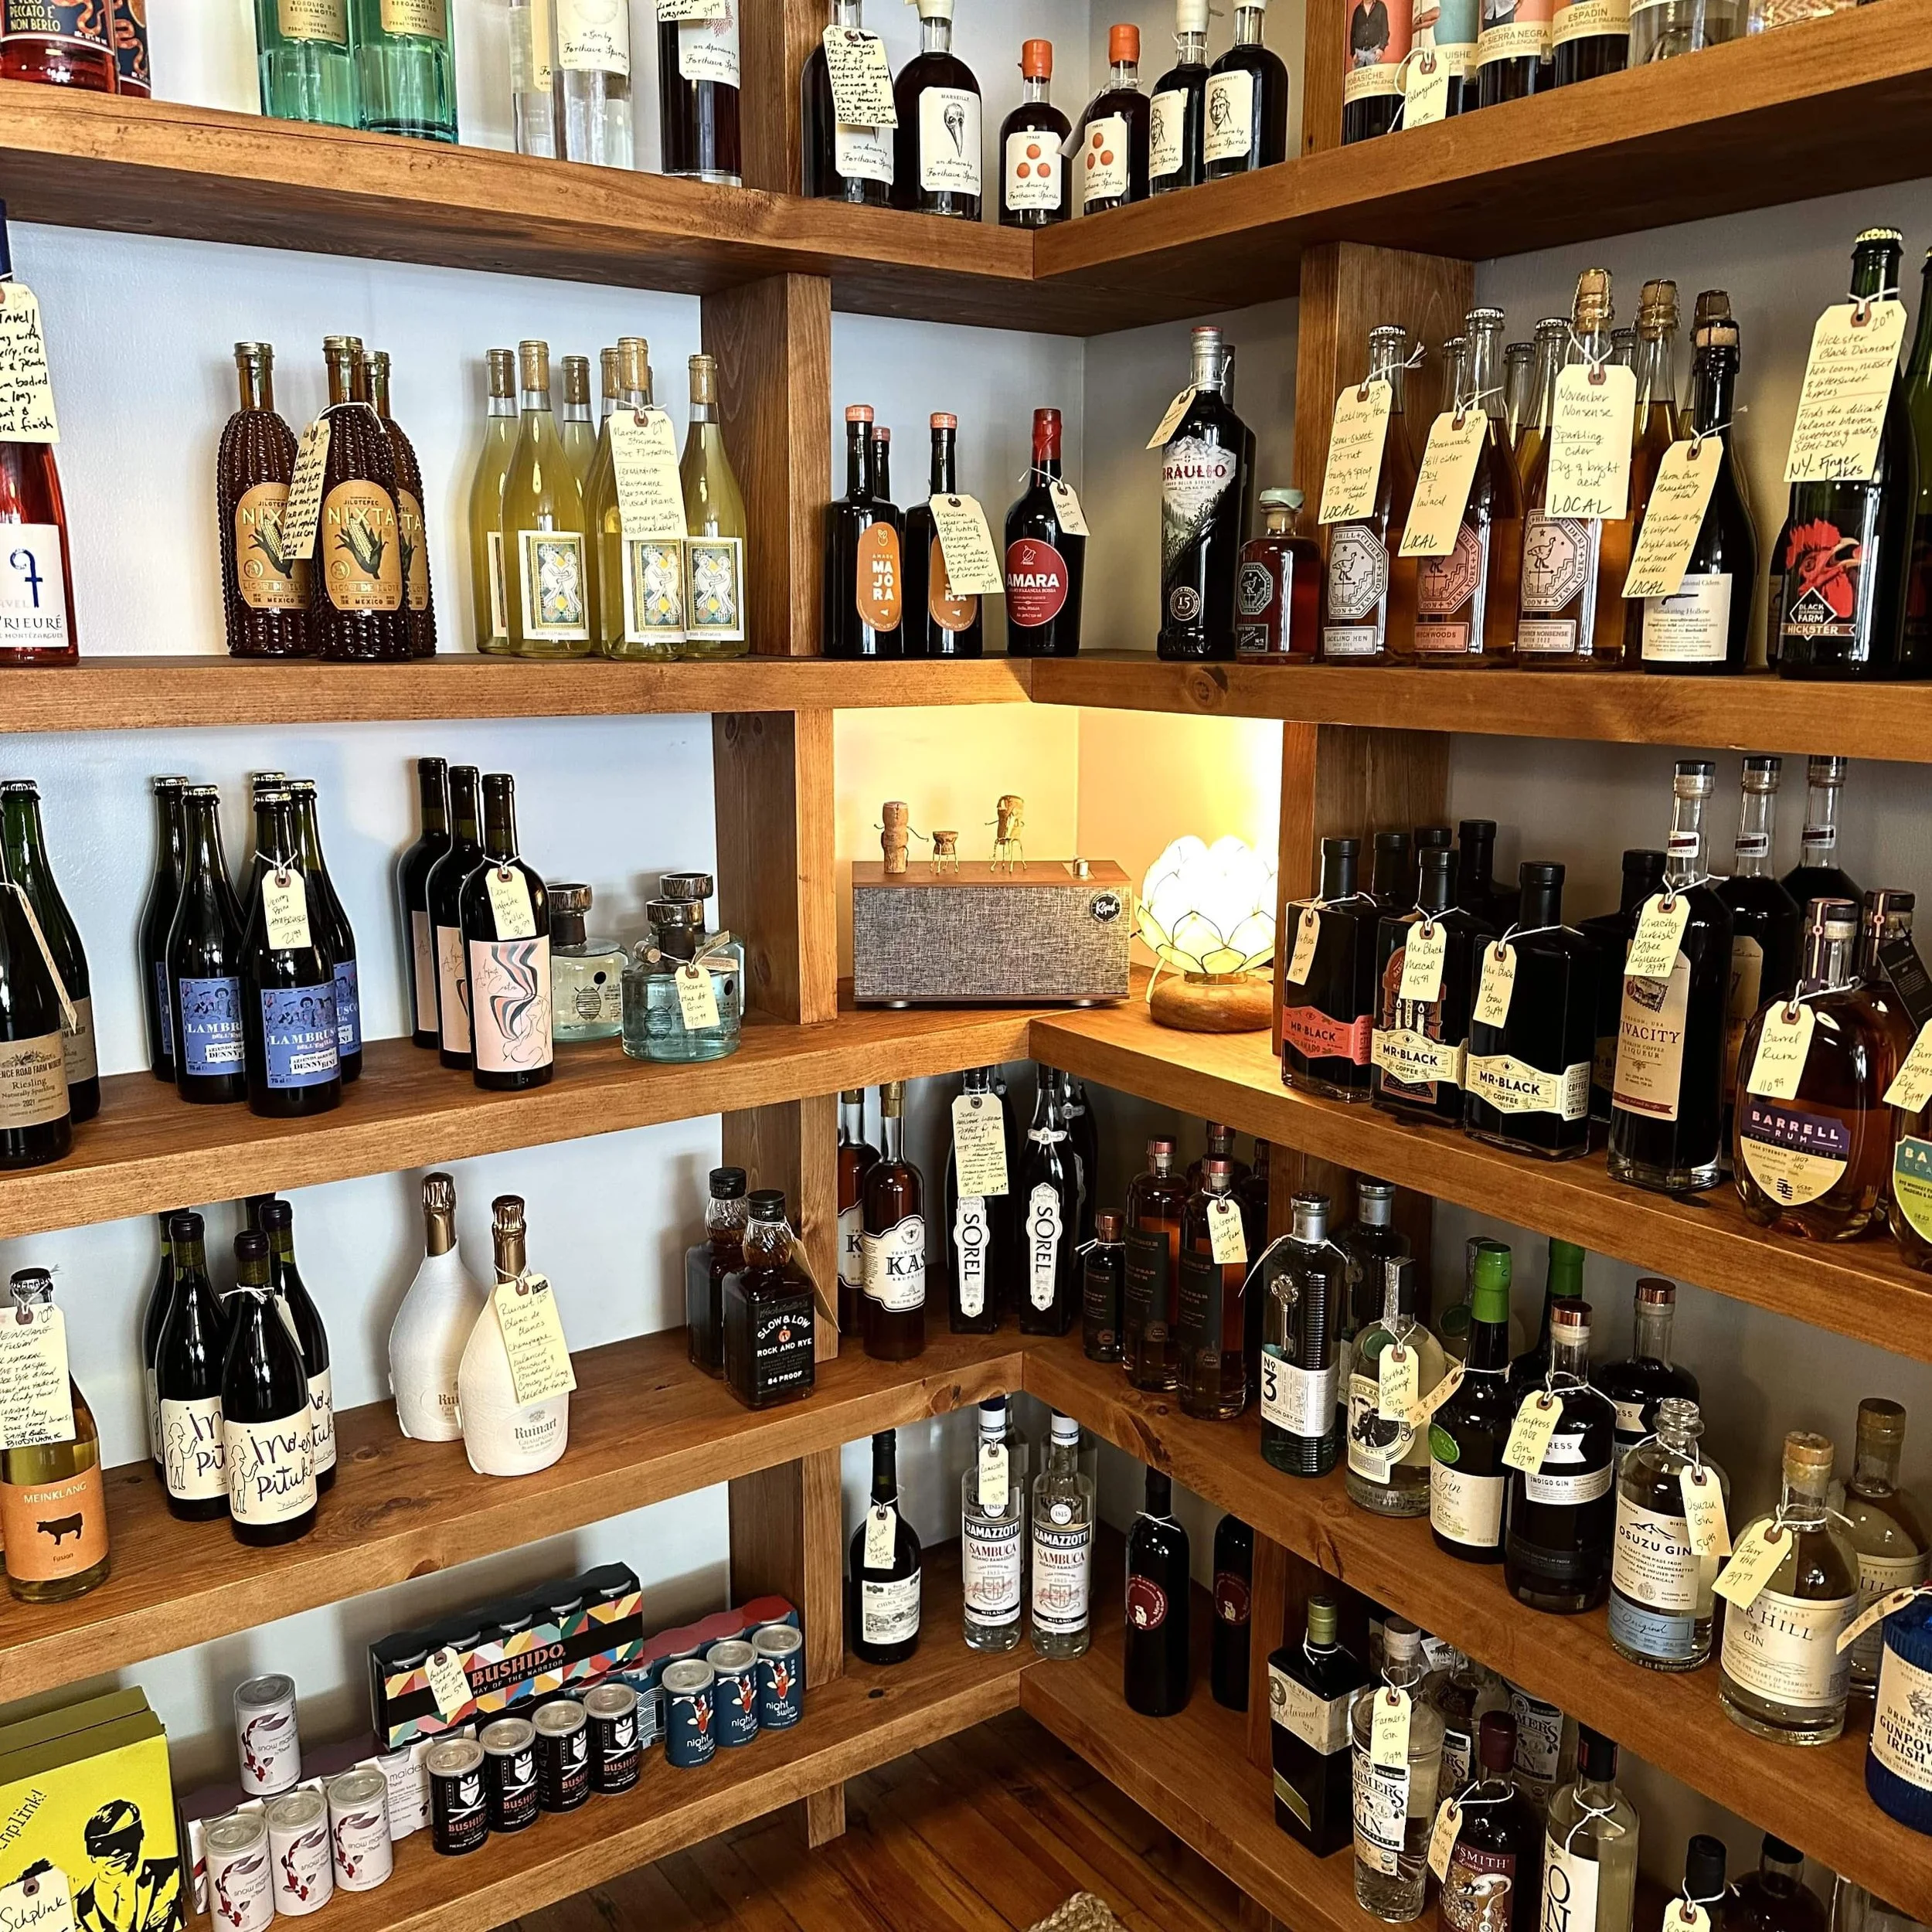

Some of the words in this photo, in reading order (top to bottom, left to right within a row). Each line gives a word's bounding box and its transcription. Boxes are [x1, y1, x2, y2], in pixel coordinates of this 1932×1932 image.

[10, 6, 45, 17] PECCATO
[1567, 8, 1609, 23] ESPADIN
[11, 19, 29, 31] NON
[31, 20, 60, 32] BERLO
[1488, 32, 1515, 44] SIERRA
[1518, 29, 1548, 39] NEGRA
[940, 94, 971, 102] MARSEILLE
[1819, 345, 1849, 359] Black
[1557, 389, 1610, 403] November
[1562, 405, 1614, 418] Nonsense
[1323, 505, 1359, 519] LOCAL
[1551, 495, 1612, 515] LOCAL
[328, 508, 395, 526] NIXTA
[1403, 528, 1437, 549] LOCAL
[872, 561, 894, 573] MA
[1007, 573, 1059, 587] AMARA
[872, 588, 895, 600] RA
[1551, 584, 1572, 606] NEW
[1627, 580, 1667, 597] LOCAL
[1178, 596, 1191, 611] 15
[1355, 597, 1372, 614] NEW
[0, 614, 62, 630] RIEURÉ
[1798, 614, 1824, 623] FARM
[1787, 624, 1838, 634] HICKSTER
[1624, 1046, 1660, 1060] LIQUEUR
[15, 1066, 32, 1077] ROAD
[33, 1063, 48, 1073] FARM
[294, 1060, 322, 1070] DENNY
[321, 1059, 336, 1069] BINI
[1395, 1065, 1419, 1076] COFFEE
[12, 1078, 46, 1090] Riesling
[2, 1089, 30, 1099] Naturally
[1494, 1093, 1519, 1106] COFFEE
[22, 1099, 36, 1107] 2021
[1751, 1110, 1839, 1141] BARRELL
[1775, 1129, 1807, 1144] RUM
[962, 1213, 983, 1281] SOREL
[1035, 1206, 1056, 1274] SOREL
[757, 1317, 781, 1340] SLOW
[791, 1315, 811, 1328] LOW
[757, 1346, 778, 1358] ROCK
[781, 1342, 796, 1352] AND
[798, 1338, 812, 1348] RYE
[767, 1376, 778, 1385] 84
[779, 1371, 803, 1383] PROOF
[1264, 1371, 1277, 1402] 3
[1263, 1400, 1281, 1417] LONDON
[1282, 1412, 1294, 1421] DRY
[1294, 1416, 1304, 1424] GIN
[514, 1417, 556, 1440] Ruinart
[1530, 1476, 1553, 1487] INDIGO
[23, 1481, 87, 1505] MEINKLANG
[965, 1521, 1019, 1538] RAMAZZOTTI
[1034, 1527, 1089, 1545] RAMAZZOTTI
[1619, 1526, 1660, 1552] OSUZU
[1665, 1546, 1692, 1556] GIN
[52, 1552, 73, 1563] Fusion
[968, 1543, 1017, 1559] SAMBUCA
[1037, 1549, 1085, 1563] SAMBUCA
[1622, 1613, 1668, 1635] Original
[1760, 1613, 1814, 1642] HILL
[1743, 1629, 1764, 1648] GIN
[471, 1643, 565, 1688] BUSHIDO
[473, 1686, 488, 1695] WAY
[507, 1675, 523, 1684] THE
[527, 1659, 563, 1675] WARRIOR
[766, 1700, 789, 1713] night
[777, 1706, 795, 1716] swim
[731, 1713, 753, 1727] night
[1886, 1706, 1932, 1736] DRUMSH
[687, 1733, 709, 1747] night
[1886, 1733, 1925, 1765] IRISH
[1459, 1856, 1484, 1872] London
